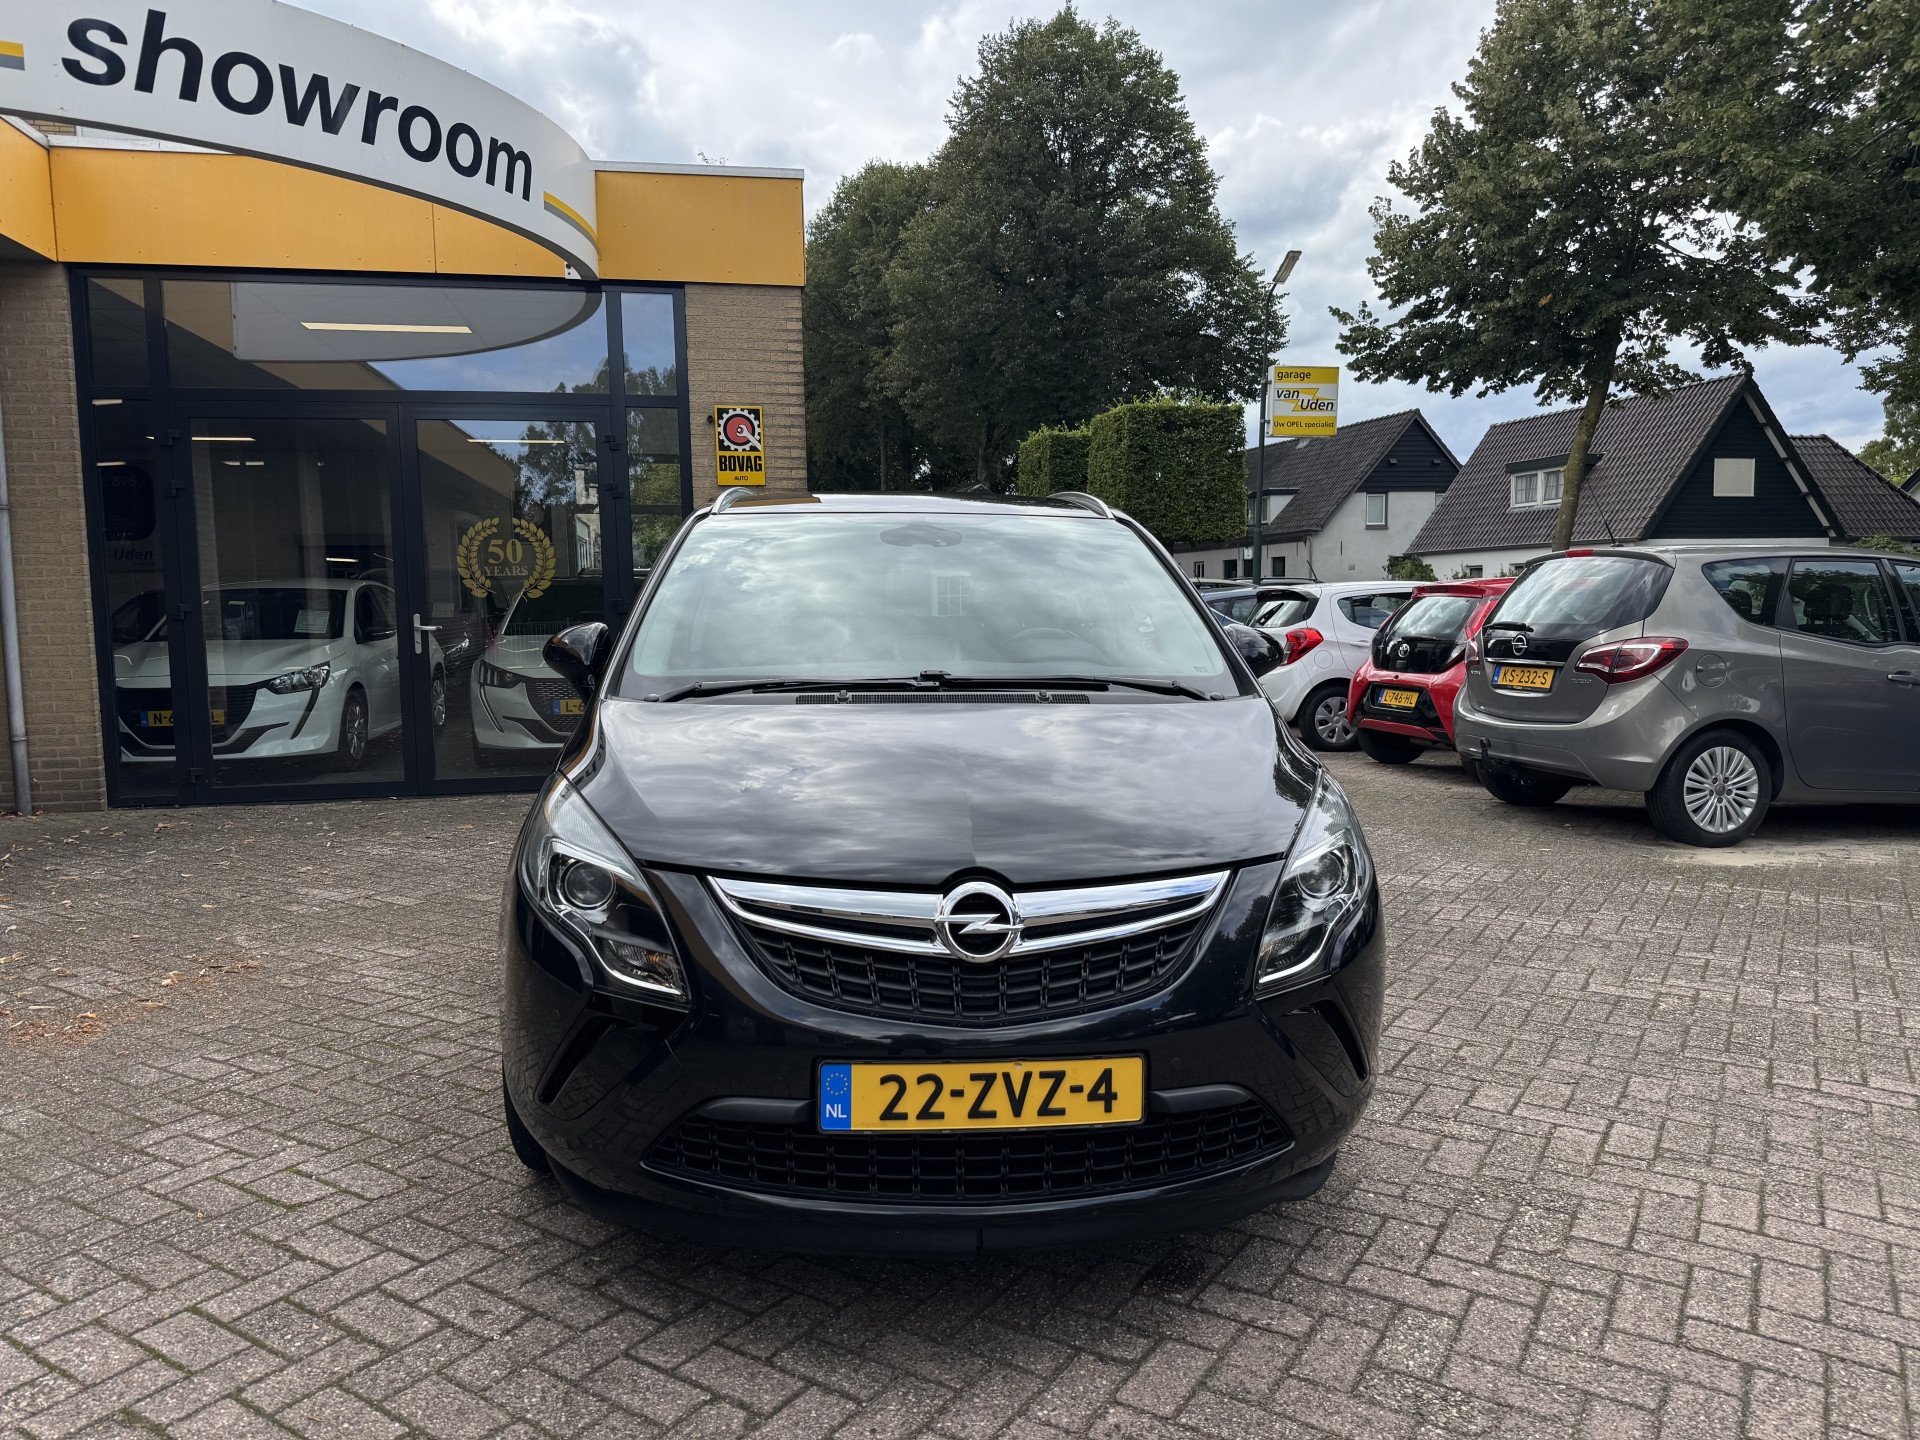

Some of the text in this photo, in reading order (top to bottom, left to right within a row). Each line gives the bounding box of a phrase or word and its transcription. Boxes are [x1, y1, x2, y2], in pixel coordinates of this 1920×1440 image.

[61, 8, 533, 202] showroom
[1277, 371, 1311, 381] garage
[1276, 389, 1299, 399] van
[1300, 399, 1334, 411] Uden
[1304, 421, 1334, 429] specialist
[719, 455, 762, 472] BOVAG
[114, 547, 153, 560] Uden
[487, 538, 523, 564] 50
[484, 565, 529, 577] YEARS
[1502, 668, 1549, 685] KS-232-S
[1383, 691, 1414, 705] L-746-HL
[878, 1067, 1118, 1121] 22-ZVZ-4
[825, 1103, 847, 1119] NL
